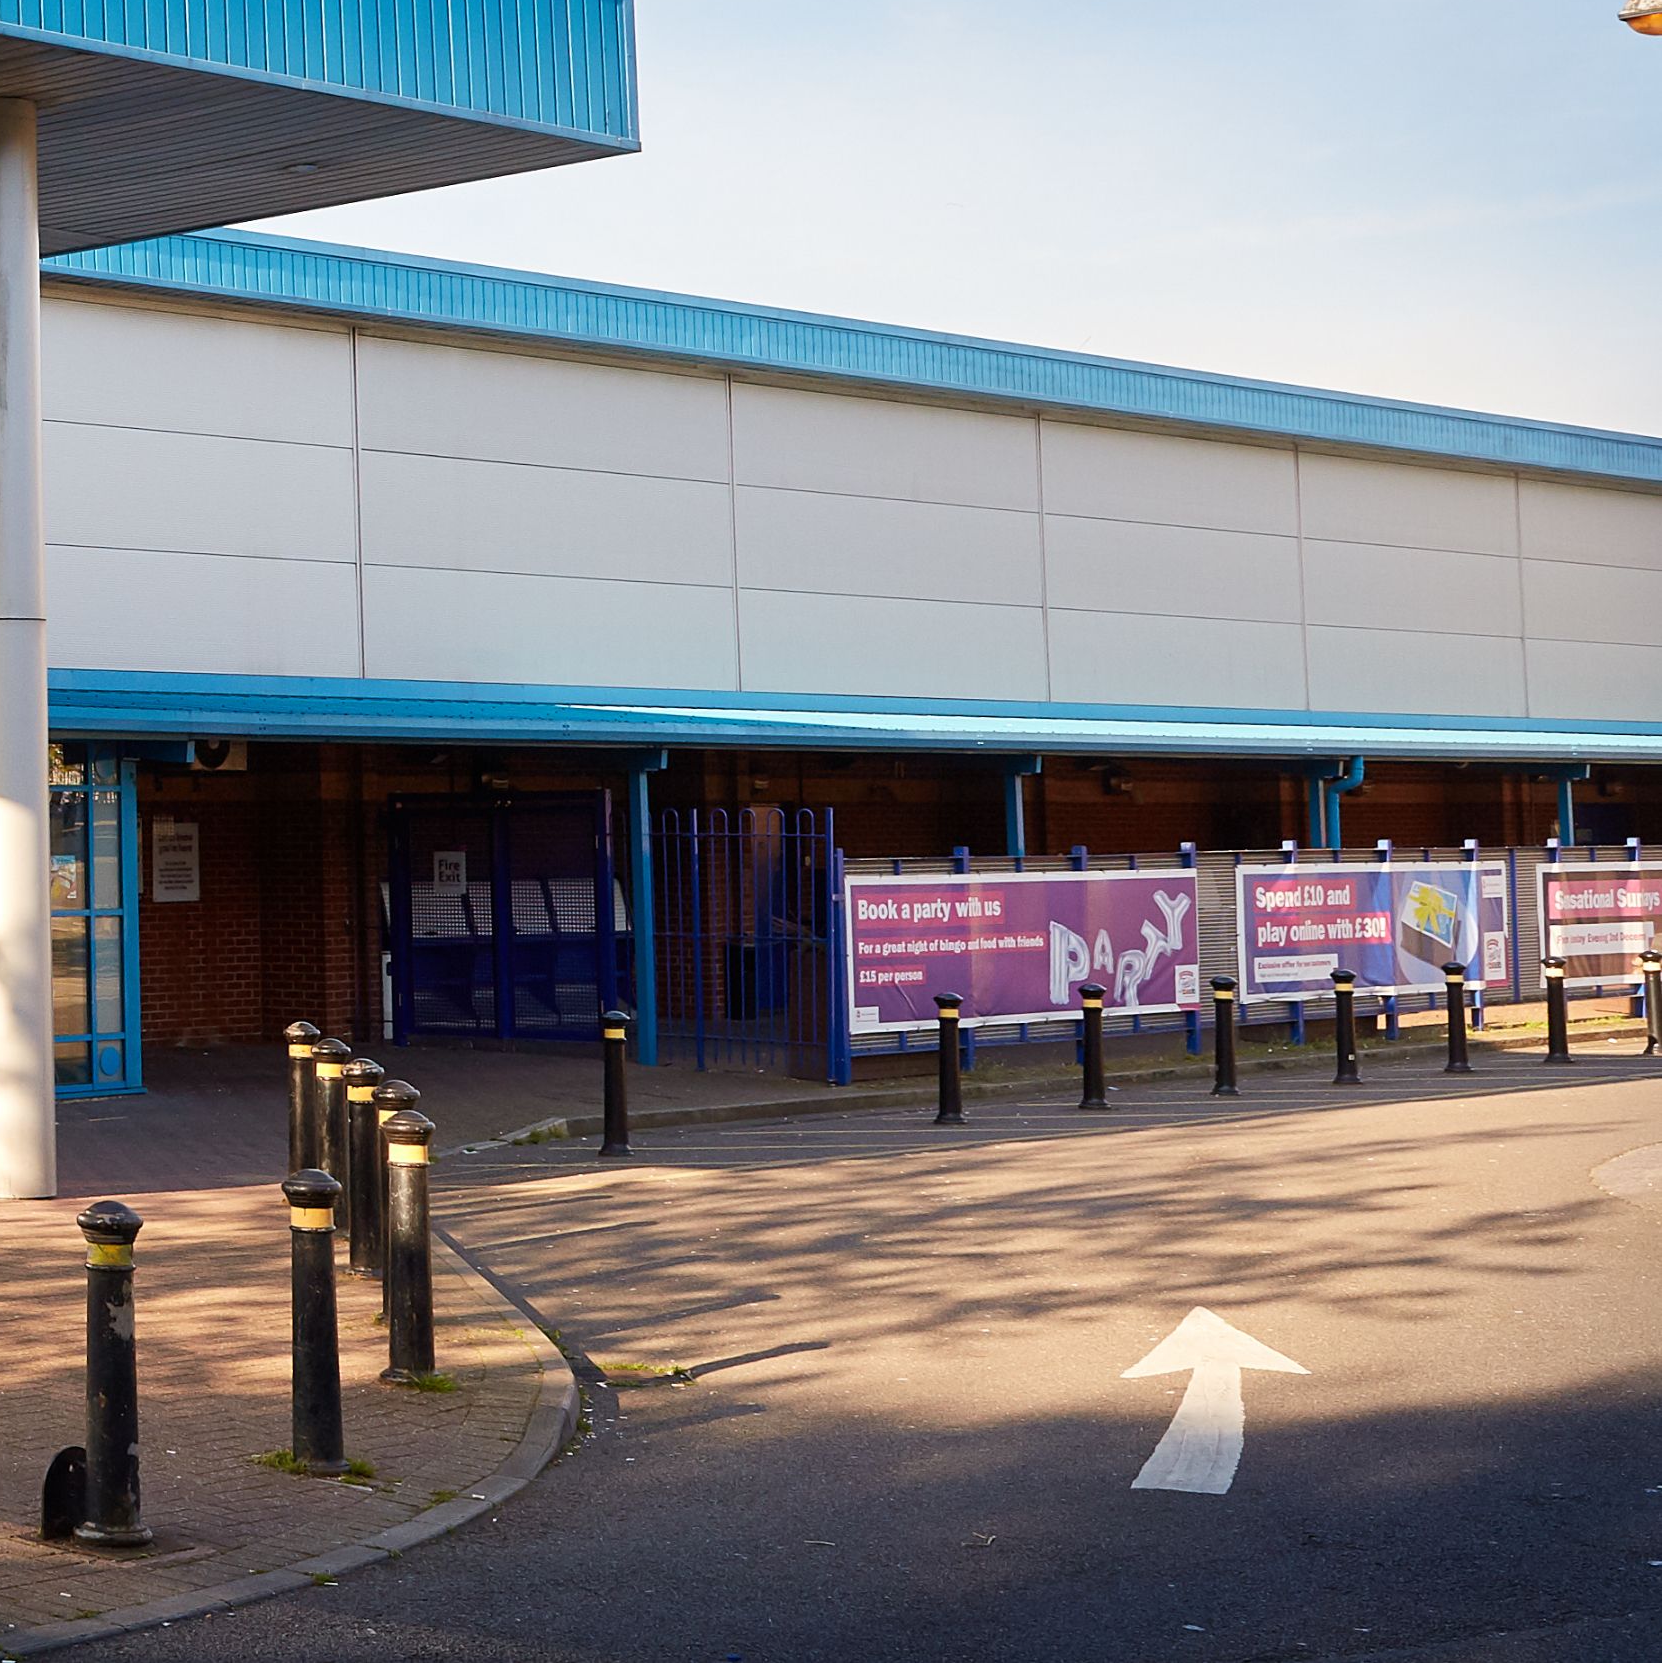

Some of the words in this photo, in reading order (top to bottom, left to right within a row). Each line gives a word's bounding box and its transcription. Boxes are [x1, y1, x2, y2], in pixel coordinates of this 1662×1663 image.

[438, 859, 460, 871] Fire
[438, 871, 461, 882] Exit
[858, 899, 898, 920] Book
[901, 903, 911, 919] a
[913, 898, 951, 923] party
[955, 897, 982, 917] with
[984, 900, 1001, 916] us
[1255, 886, 1301, 912] Spend
[1304, 885, 1324, 906] £10
[1327, 885, 1350, 905] and
[1554, 889, 1614, 910] Ssational
[1616, 888, 1660, 911] Sunays
[1257, 922, 1287, 947] play
[1290, 919, 1325, 941] online
[1327, 918, 1353, 939] with
[1355, 917, 1386, 938] £30!
[858, 942, 874, 955] For
[875, 944, 881, 954] a
[882, 941, 906, 956] great
[907, 940, 928, 955] night
[929, 939, 938, 952] of
[939, 938, 966, 954] bingo
[998, 936, 1017, 948] with
[1017, 935, 1044, 947] friends
[1049, 890, 1192, 1006] PARTY
[859, 970, 876, 983] £15
[878, 971, 893, 984] per
[894, 969, 923, 984] person
